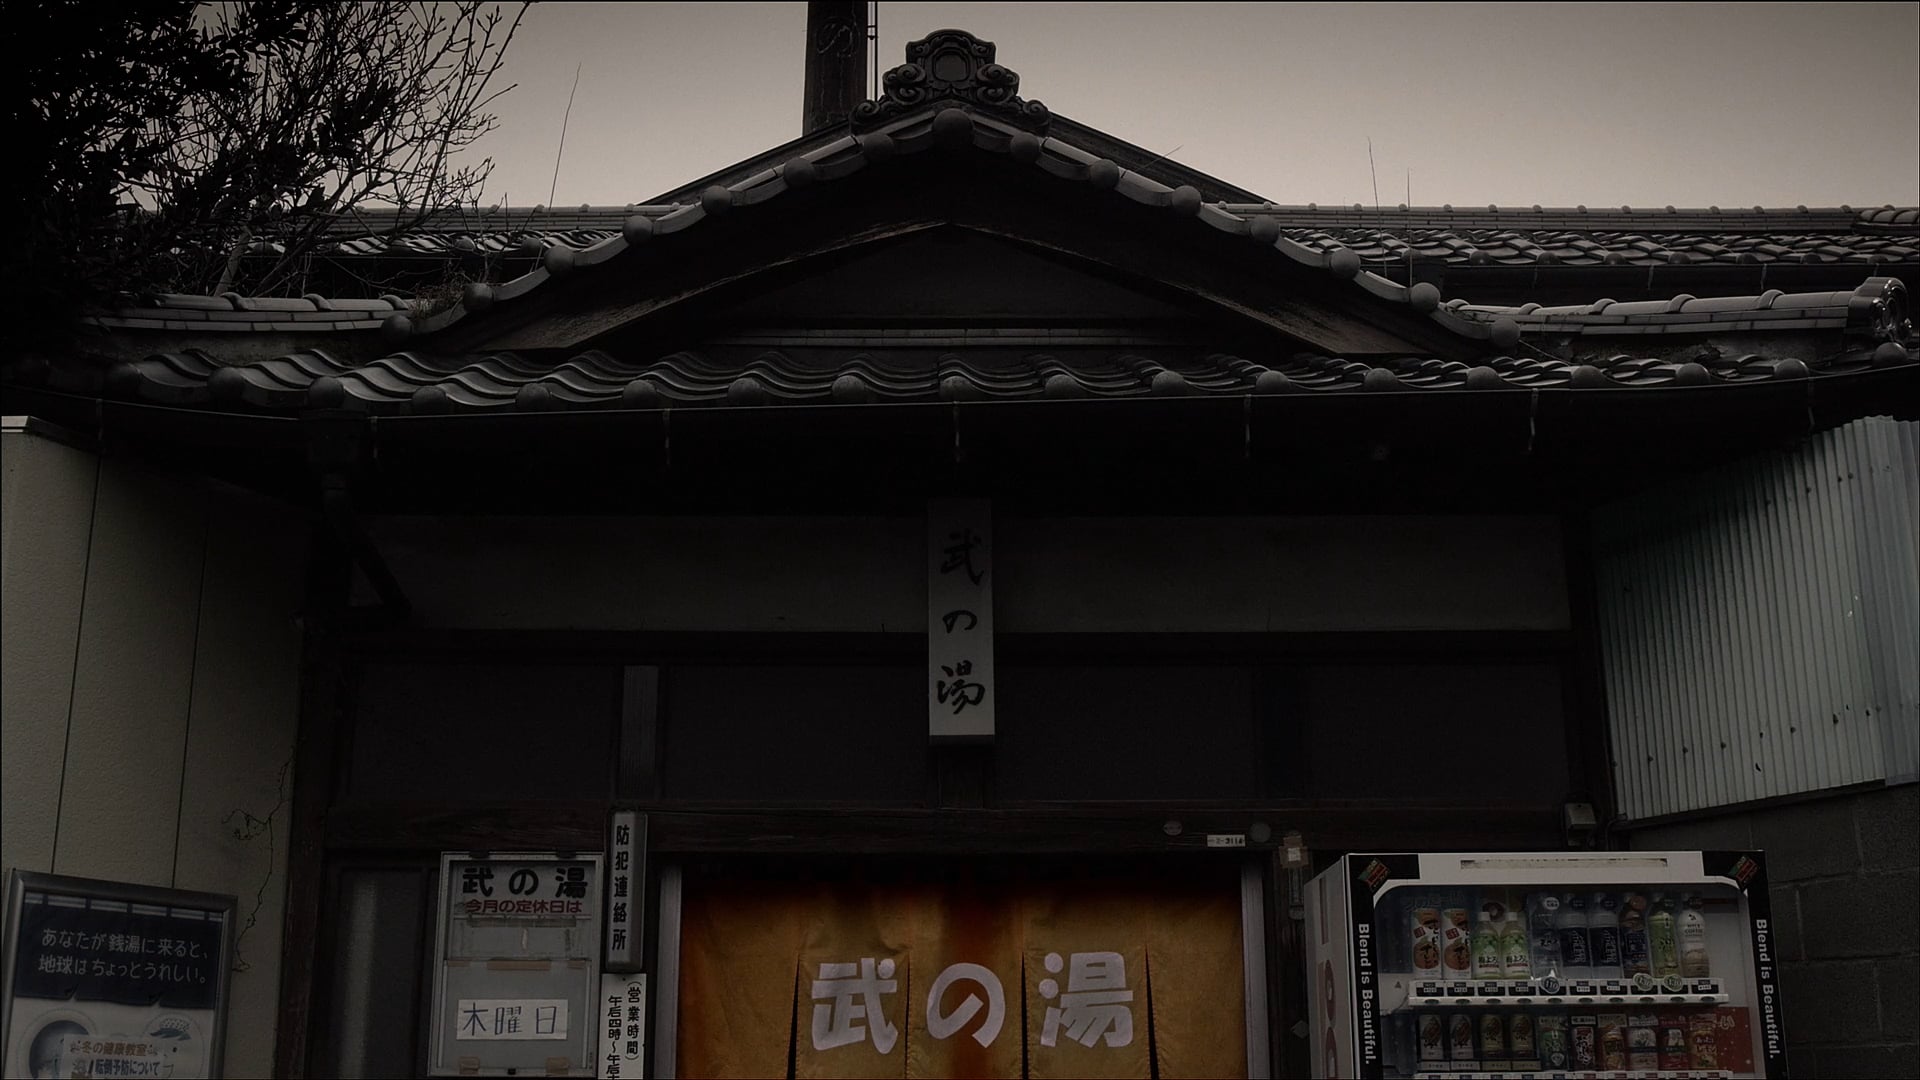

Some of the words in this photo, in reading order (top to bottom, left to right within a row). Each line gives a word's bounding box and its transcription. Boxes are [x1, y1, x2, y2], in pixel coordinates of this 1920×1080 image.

[938, 528, 985, 715] 武の湯
[462, 867, 588, 898] 武の湯
[612, 825, 630, 950] 防犯連絡所
[466, 899, 582, 914] 今月の定休日は
[41, 928, 208, 959] あなたが銭湯に来ると、
[1357, 922, 1372, 972] Blend
[1755, 918, 1770, 963] Blend
[38, 954, 207, 984] 地球はちょっとうれしい。
[1360, 974, 1372, 984] is
[462, 1003, 557, 1036] 木曜日
[811, 951, 1135, 1055] 武の湯
[1361, 990, 1377, 1065] Beautiful.
[1762, 984, 1782, 1060] Beautiful.
[81, 1040, 147, 1057] 冬の健康教室
[95, 1059, 160, 1076] 転倒予防について
